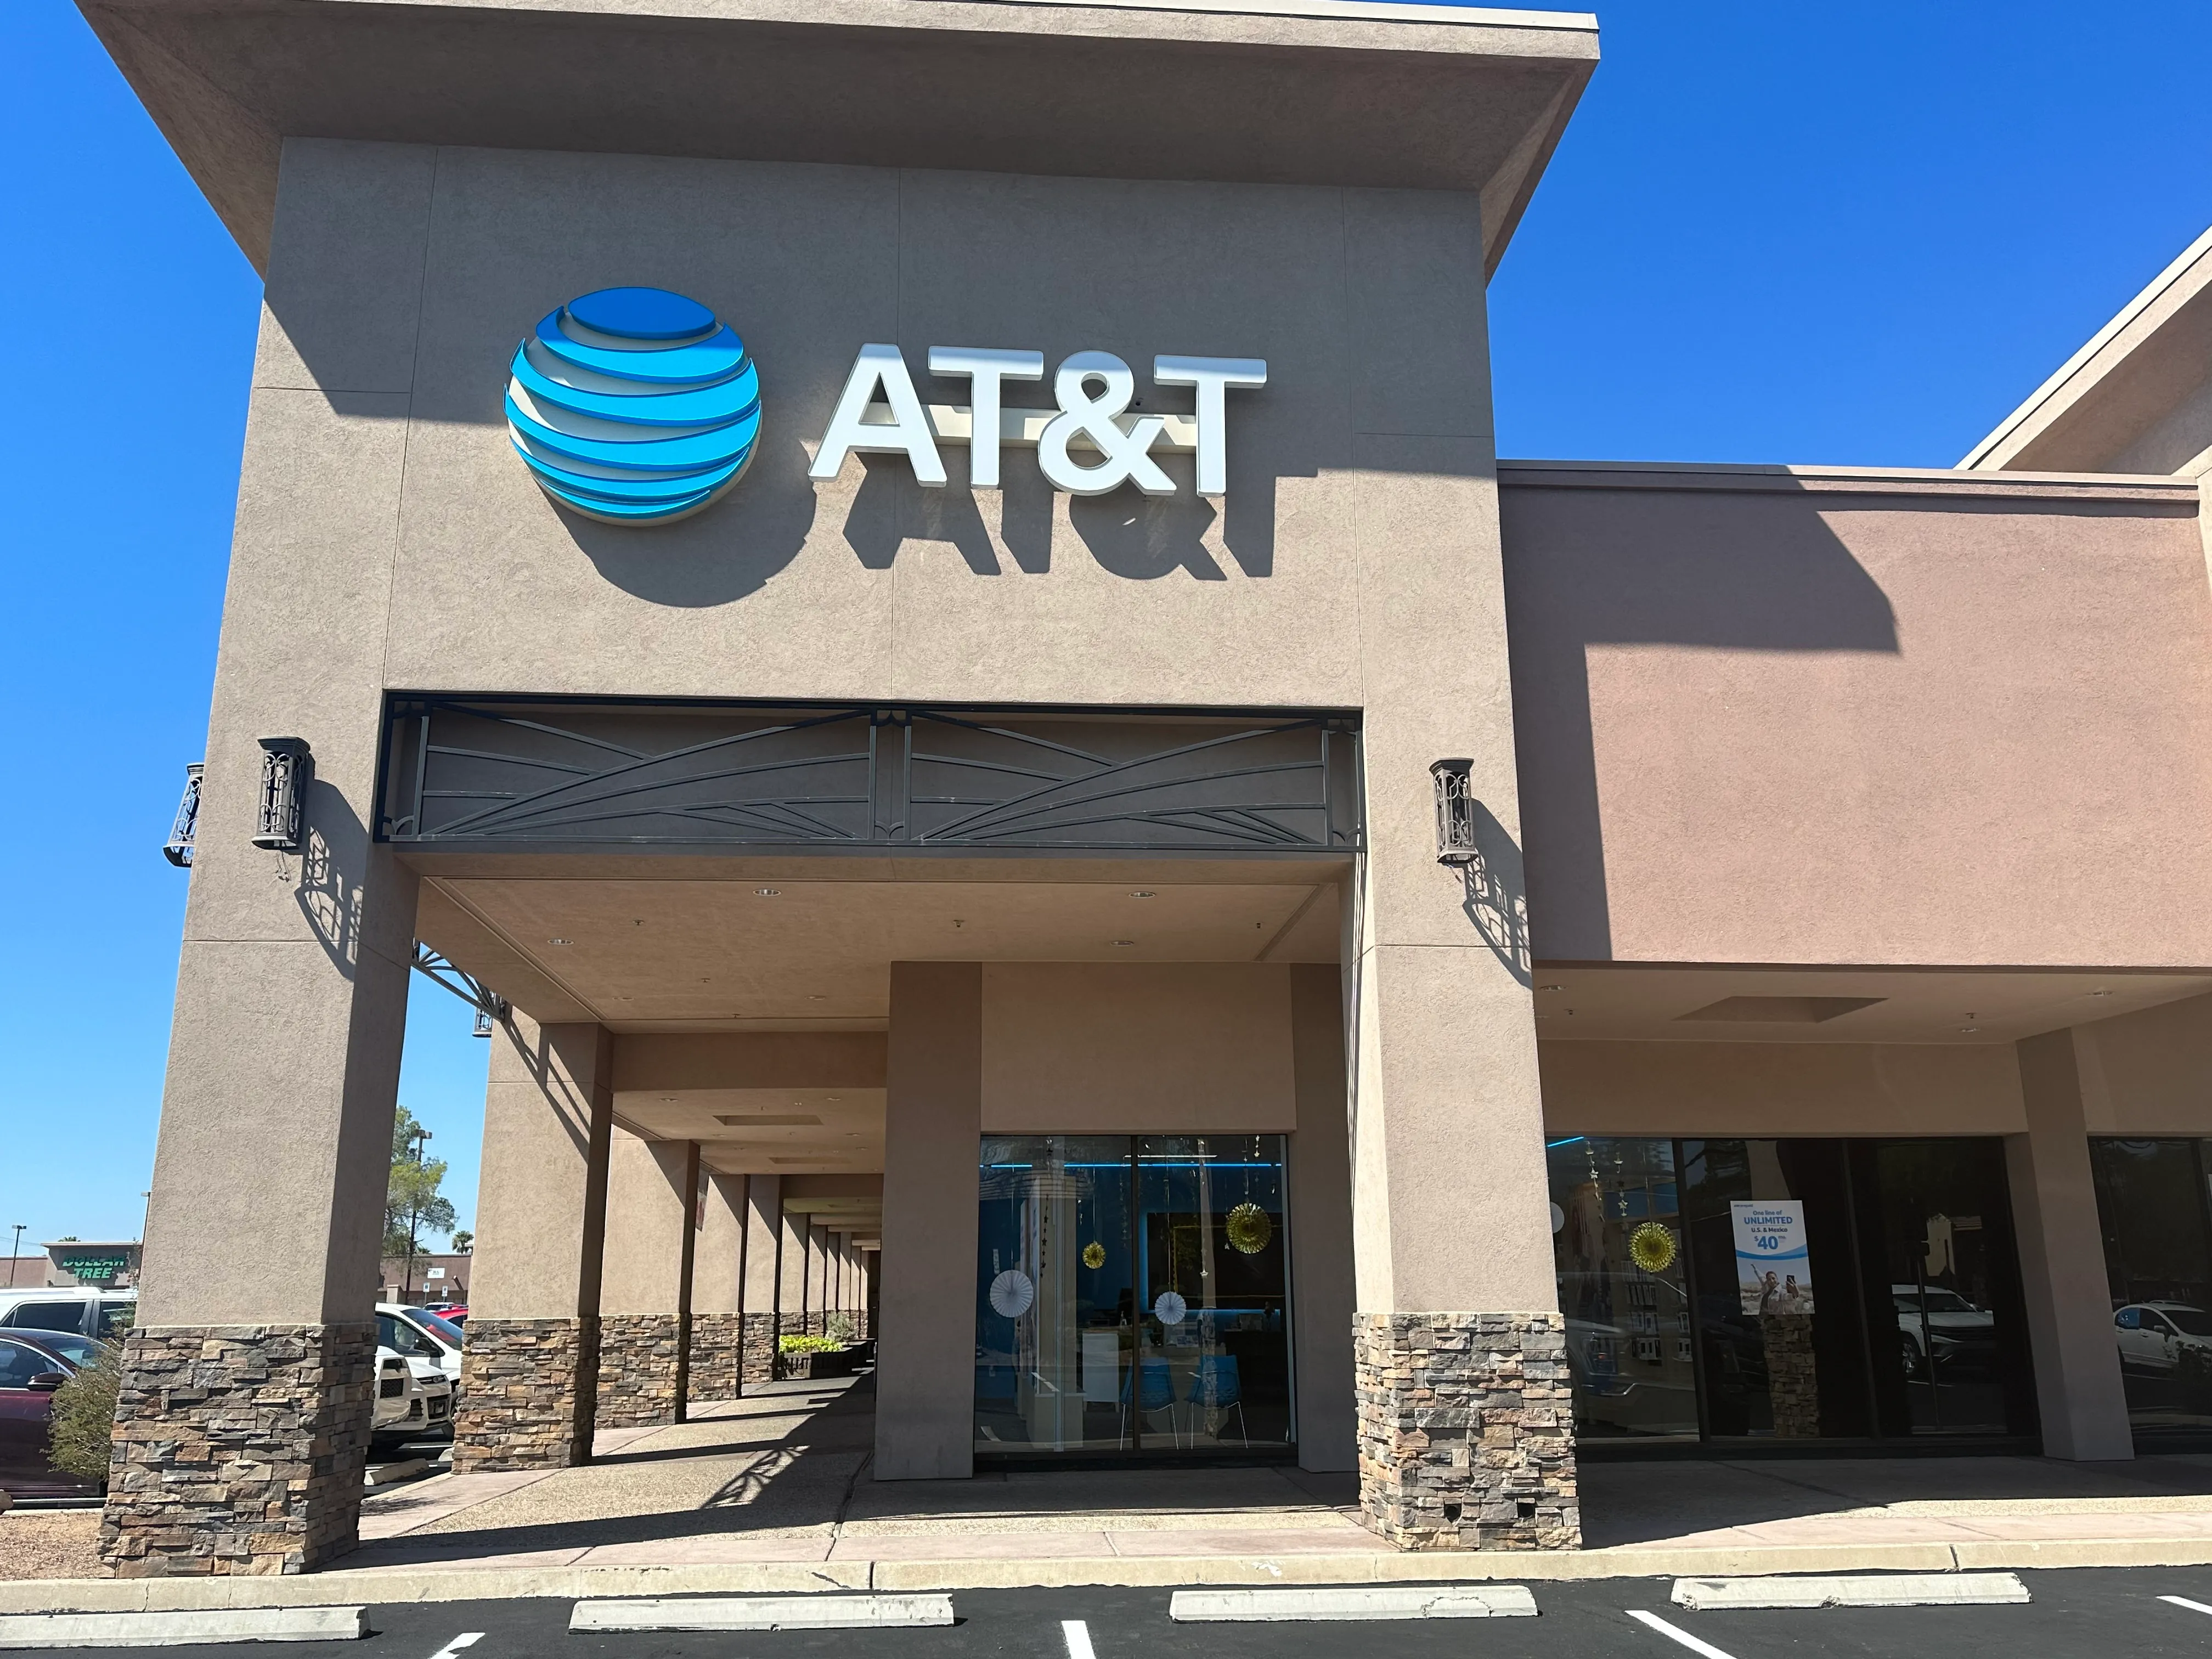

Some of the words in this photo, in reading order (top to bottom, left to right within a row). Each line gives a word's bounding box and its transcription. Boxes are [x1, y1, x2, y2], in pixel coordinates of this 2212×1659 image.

[808, 343, 1267, 497] AT&T
[63, 1256, 125, 1266] DOLLAR
[74, 1268, 112, 1278] TREE
